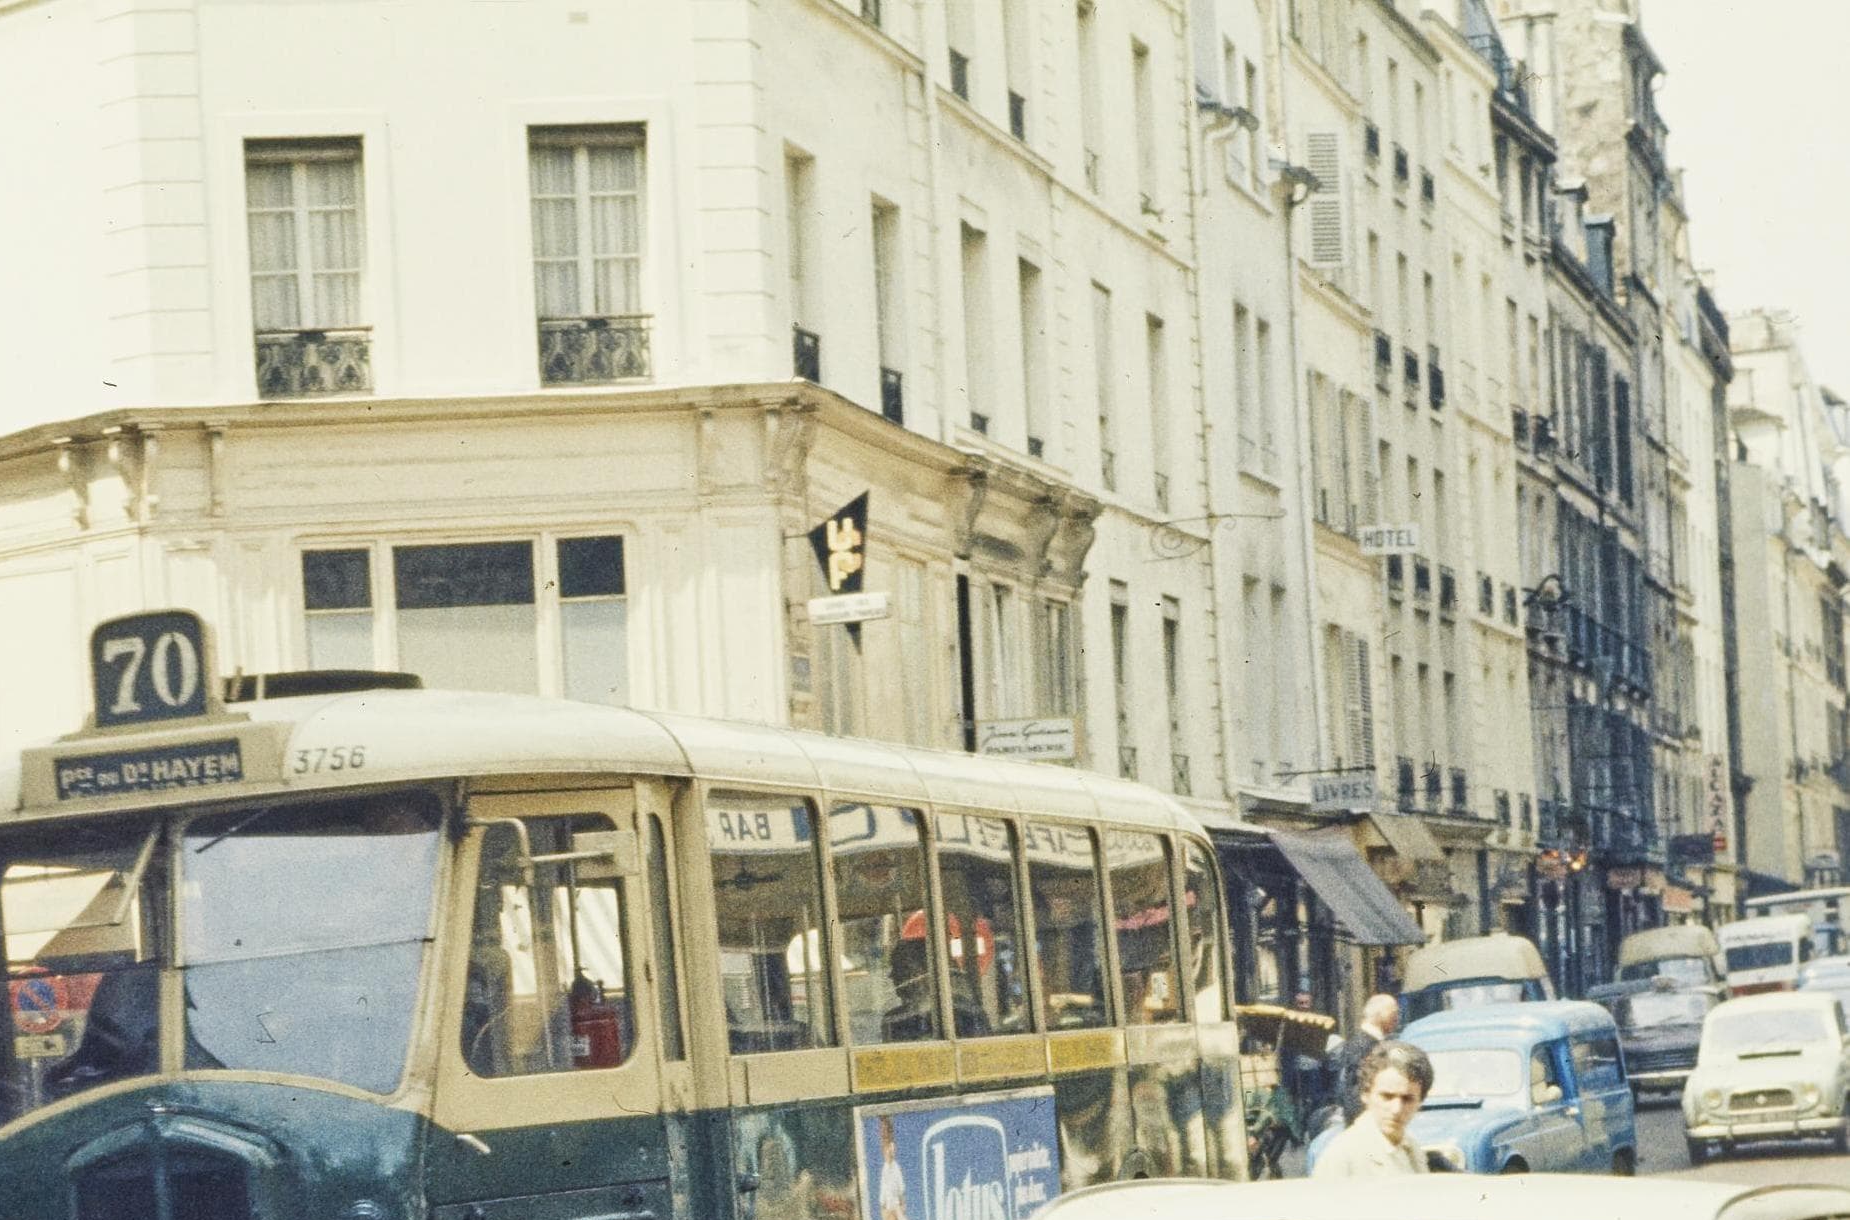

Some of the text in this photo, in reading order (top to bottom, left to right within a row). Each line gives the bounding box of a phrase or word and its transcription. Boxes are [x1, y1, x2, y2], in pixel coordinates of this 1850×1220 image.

[102, 631, 199, 714] 70
[152, 752, 240, 782] HAYEM
[293, 745, 367, 775] 3756
